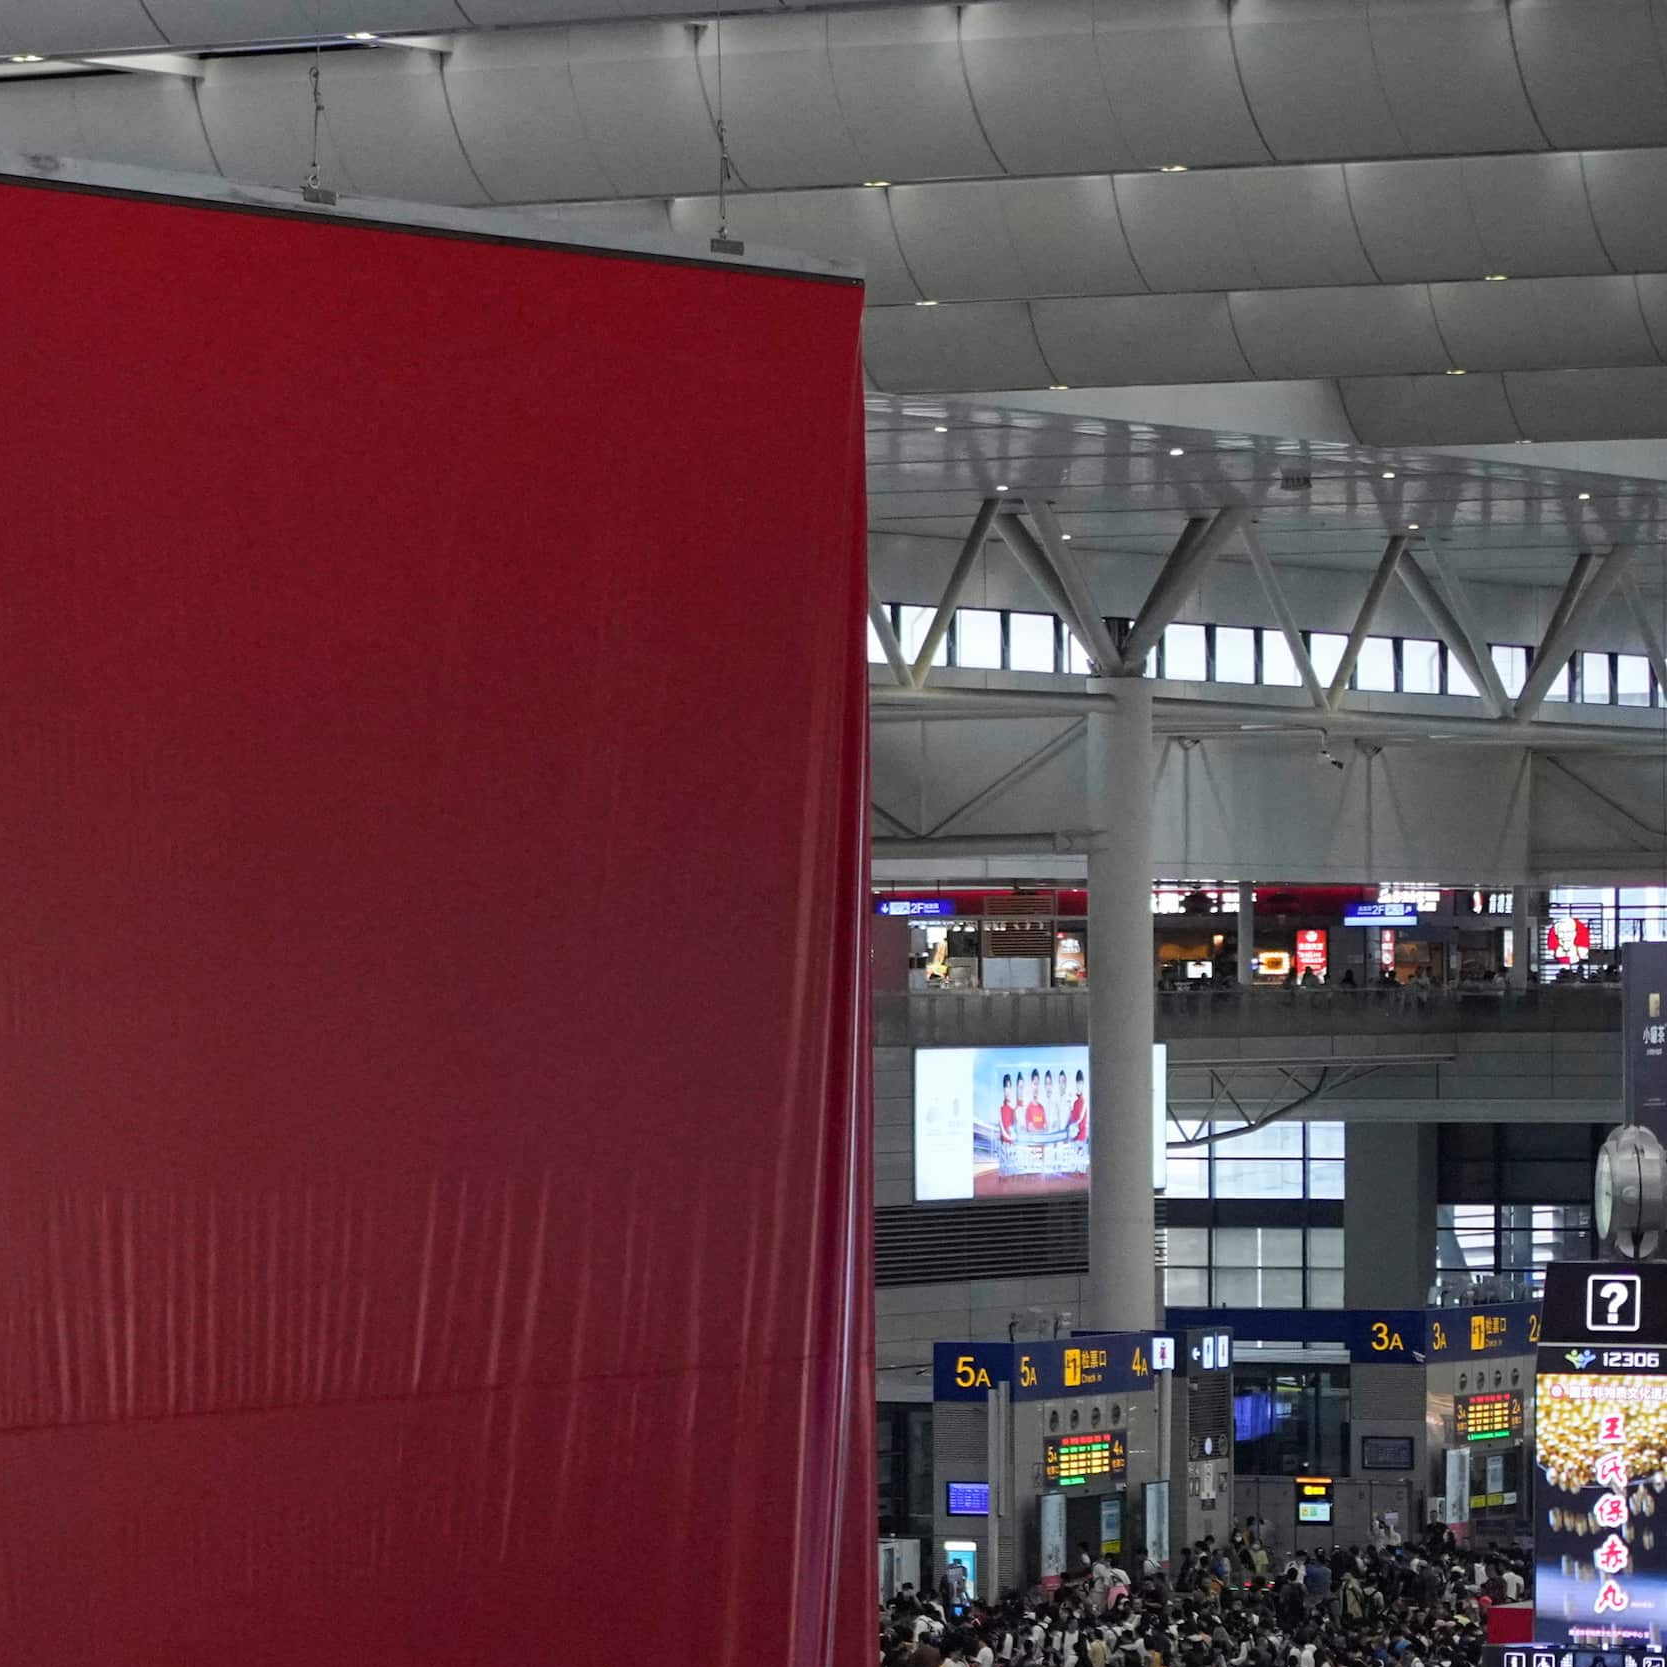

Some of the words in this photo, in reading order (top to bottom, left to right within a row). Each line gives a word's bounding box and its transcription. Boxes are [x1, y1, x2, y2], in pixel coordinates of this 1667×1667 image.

[1371, 1321, 1404, 1351] 3A
[1432, 1321, 1447, 1351] 3A
[955, 1356, 992, 1388] 5A
[1019, 1356, 1038, 1387] 5A
[1131, 1347, 1149, 1377] 4A
[1603, 1351, 1660, 1368] 12306
